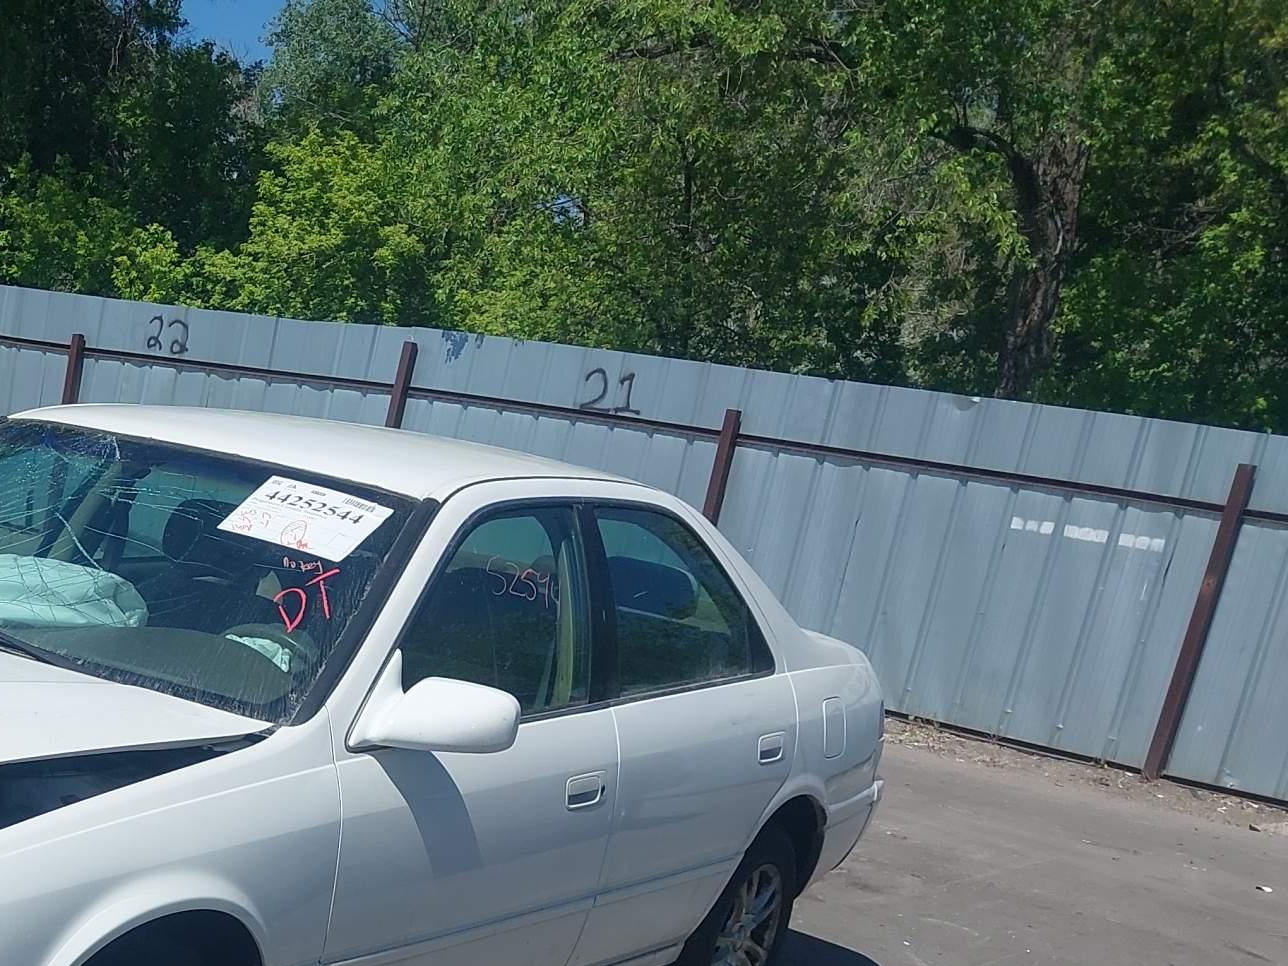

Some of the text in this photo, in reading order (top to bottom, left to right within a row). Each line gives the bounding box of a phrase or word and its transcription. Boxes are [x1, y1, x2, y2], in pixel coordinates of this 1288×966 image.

[147, 314, 189, 354] 22
[579, 368, 641, 415] 21
[265, 490, 365, 525] 44252544
